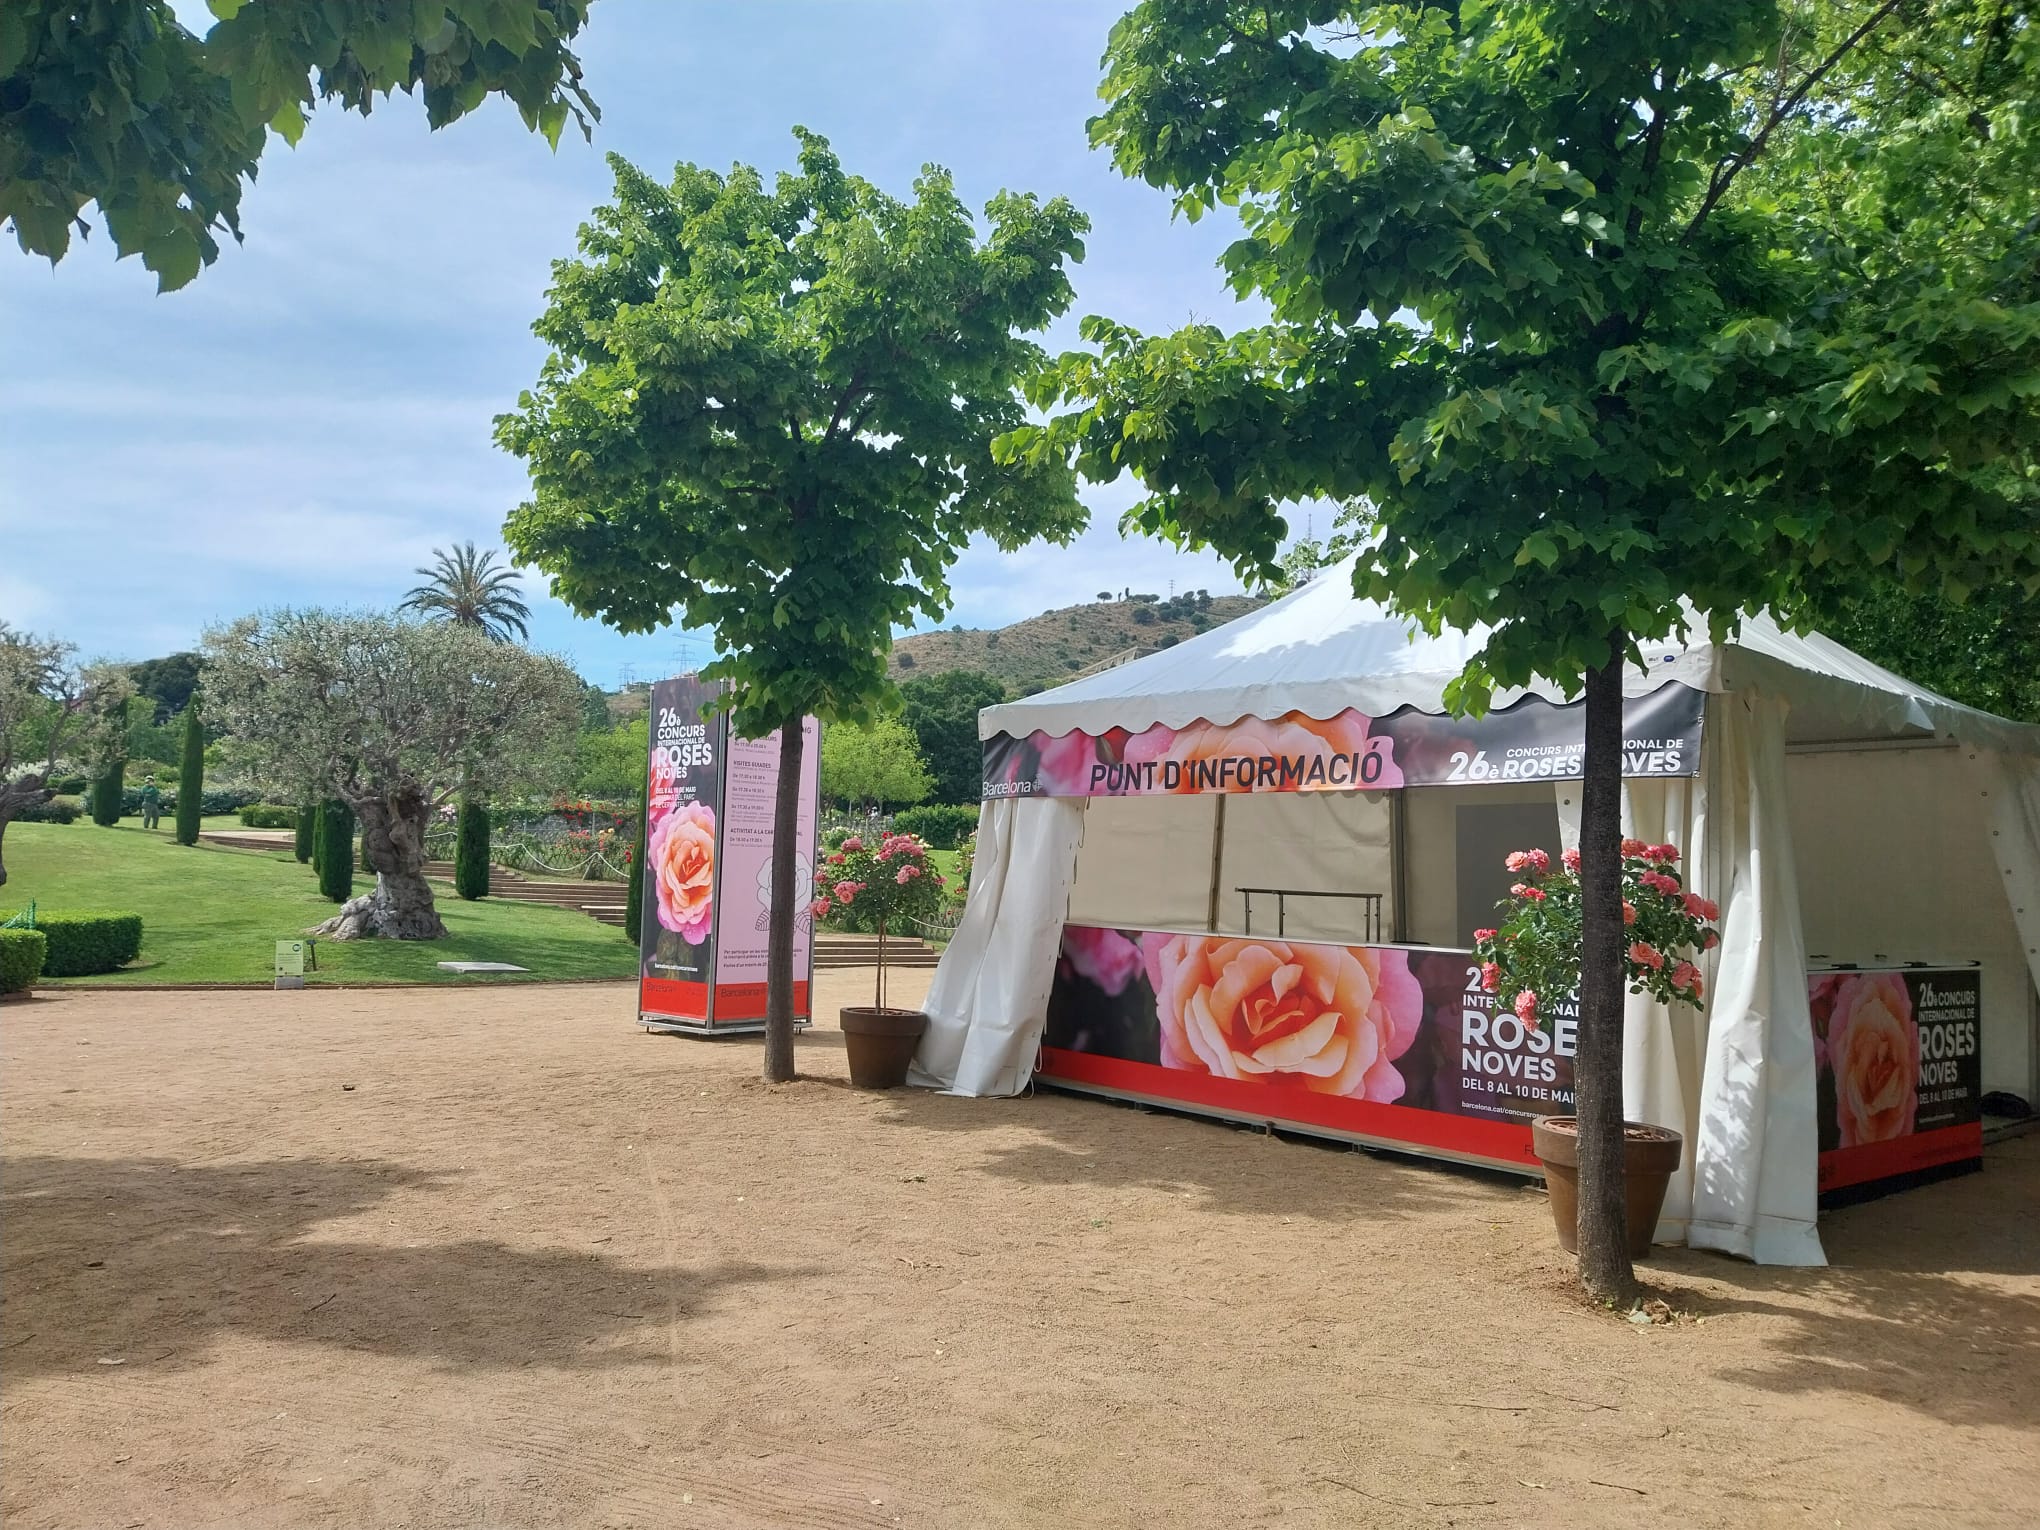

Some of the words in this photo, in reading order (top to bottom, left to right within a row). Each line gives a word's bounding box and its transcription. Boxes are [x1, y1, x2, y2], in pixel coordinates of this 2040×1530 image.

[657, 724, 706, 740] CONCURS
[656, 743, 712, 768] ROSES
[1506, 745, 1562, 758] CONCURS
[1666, 738, 1684, 749] DE
[656, 766, 688, 779] NOVES
[1090, 761, 1158, 792] PUNT
[1164, 741, 1383, 790] D'INFORMACIÓ
[1446, 750, 1500, 780] 26è
[1502, 754, 1581, 778] ROSES
[982, 779, 1032, 796] Barcelona
[1938, 990, 1975, 1006] CONCURS
[1918, 1008, 1966, 1022] INTERNACIONAL
[1462, 1010, 1579, 1057] ROSE
[1919, 1022, 1974, 1060] ROSES
[1462, 1048, 1556, 1082] NOVES
[1919, 1060, 1958, 1087] NOVES
[1462, 1077, 1484, 1090] DEL
[1488, 1081, 1494, 1092] 8
[1496, 1082, 1512, 1095] AL
[1516, 1084, 1528, 1097] 10
[1532, 1088, 1548, 1100] DE
[1552, 1090, 1574, 1104] MAI
